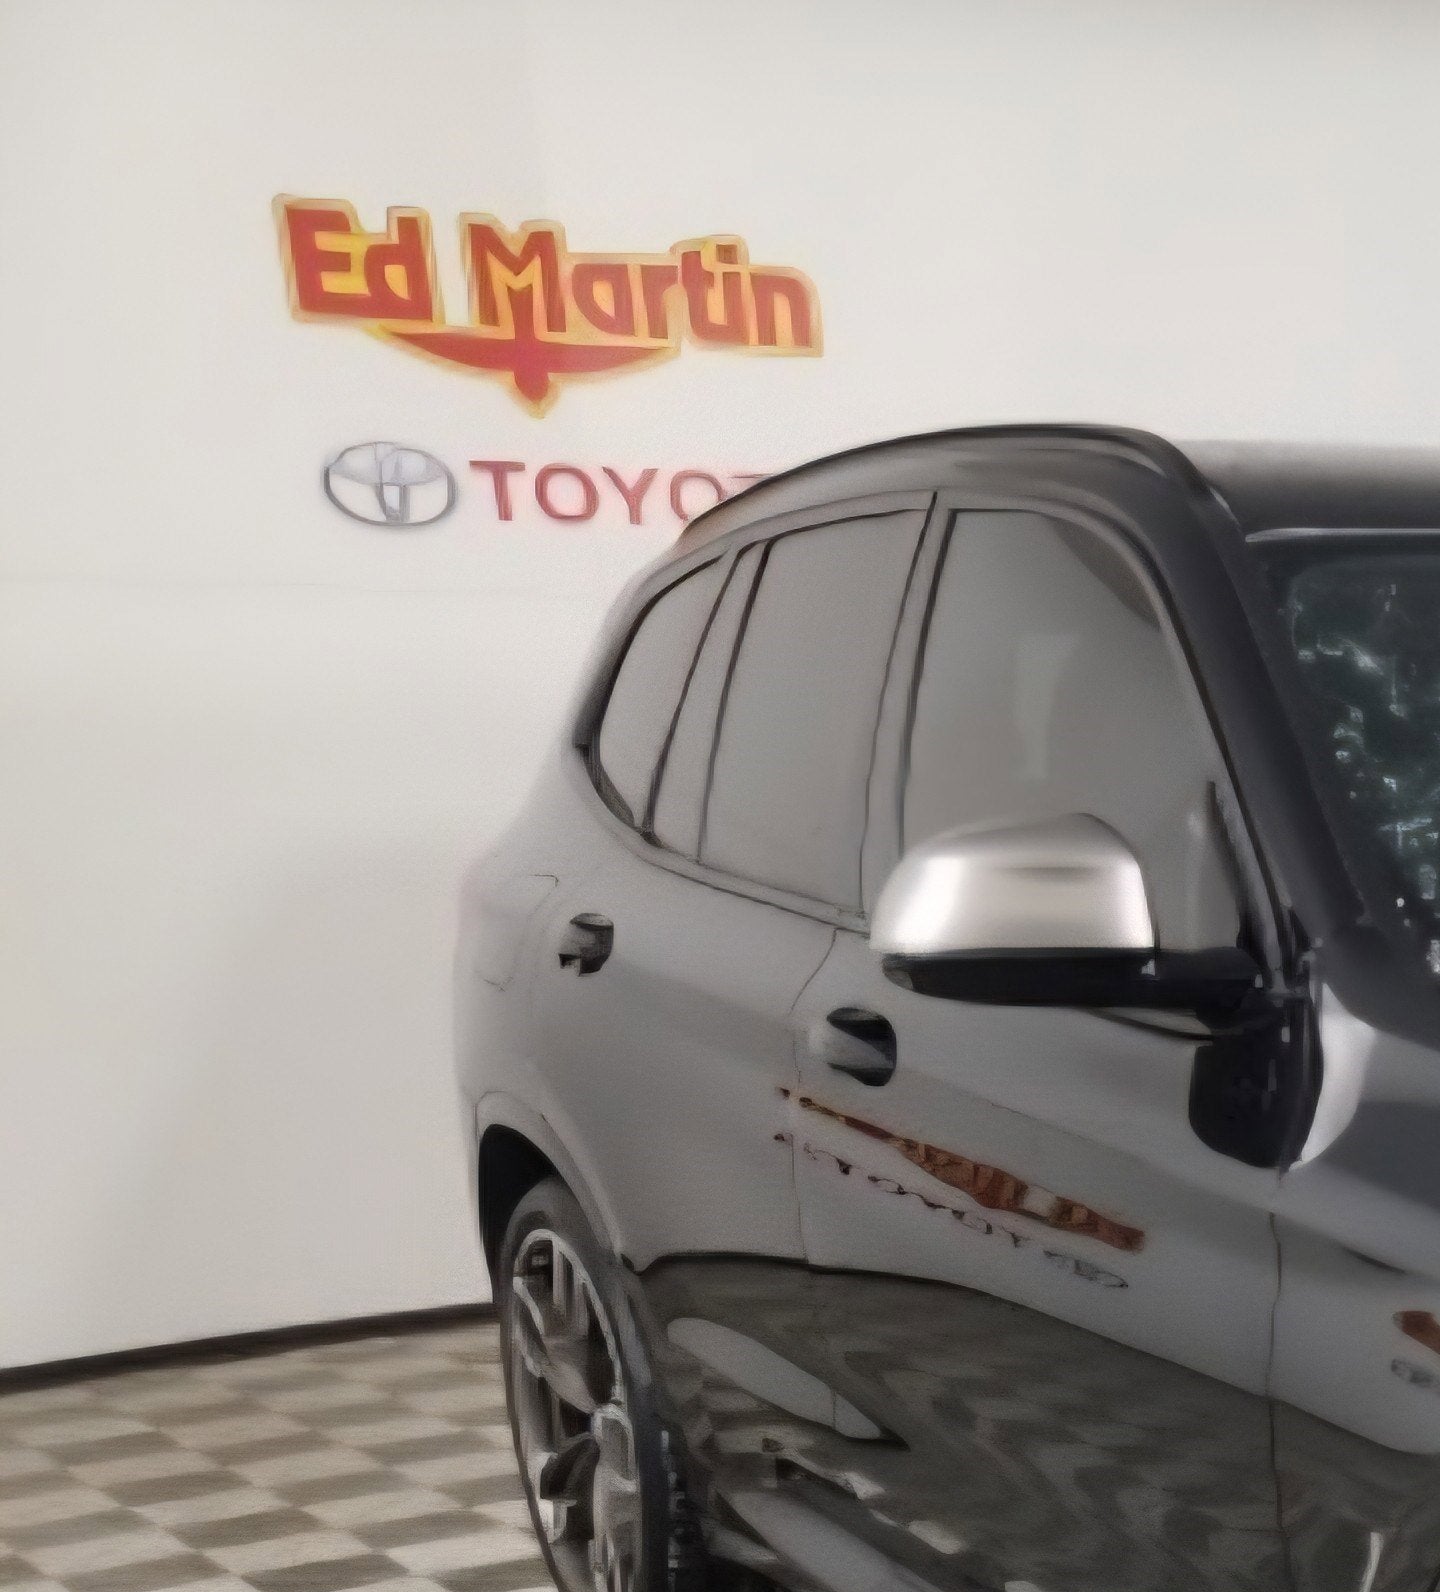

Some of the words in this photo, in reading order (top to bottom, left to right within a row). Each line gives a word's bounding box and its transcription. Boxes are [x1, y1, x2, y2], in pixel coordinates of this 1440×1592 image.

[280, 202, 437, 322] Ed
[465, 218, 815, 350] Martin
[468, 458, 774, 526] TOYO
